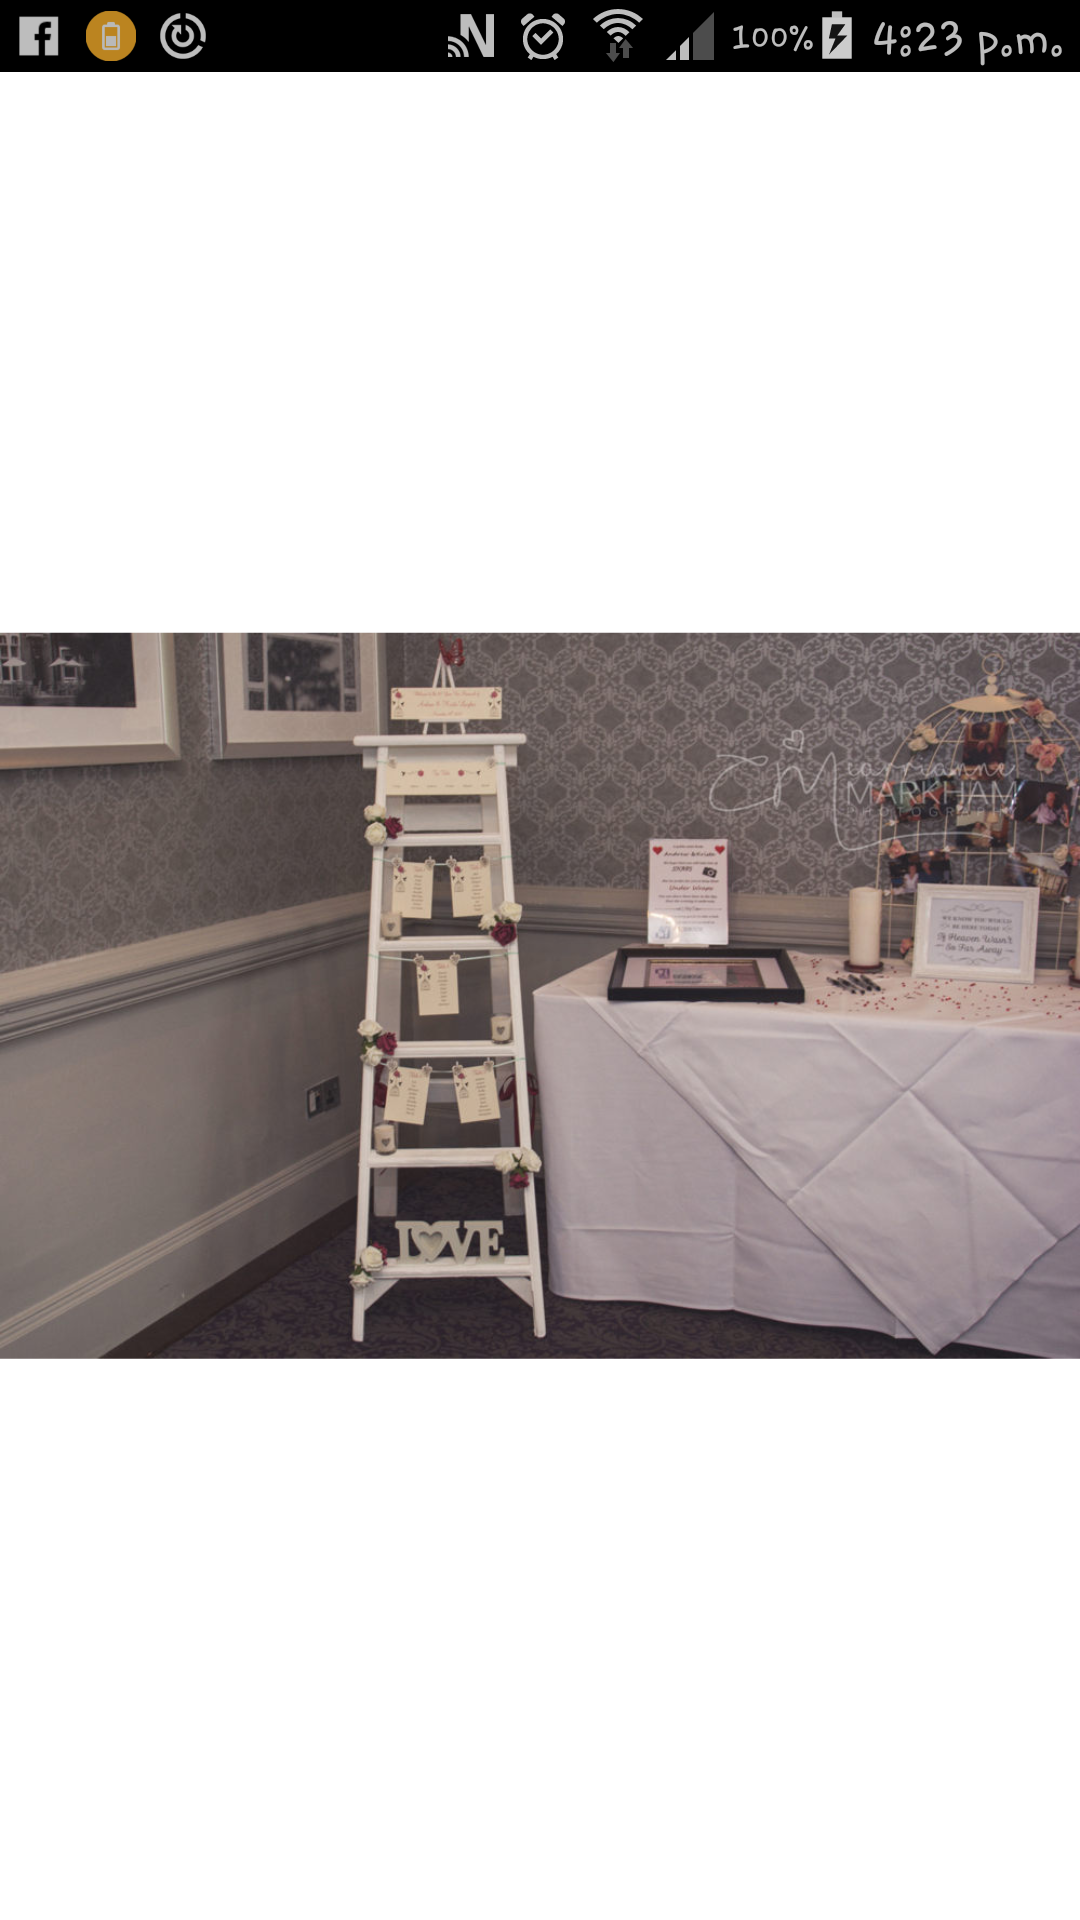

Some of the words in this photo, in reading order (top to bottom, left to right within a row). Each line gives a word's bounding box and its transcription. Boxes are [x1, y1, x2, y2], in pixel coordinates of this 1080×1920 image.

[733, 25, 813, 52] 100%
[874, 21, 962, 57] 4:23
[979, 32, 1062, 66] p.m.
[948, 933, 980, 942] Heaven
[976, 945, 1003, 956] Away
